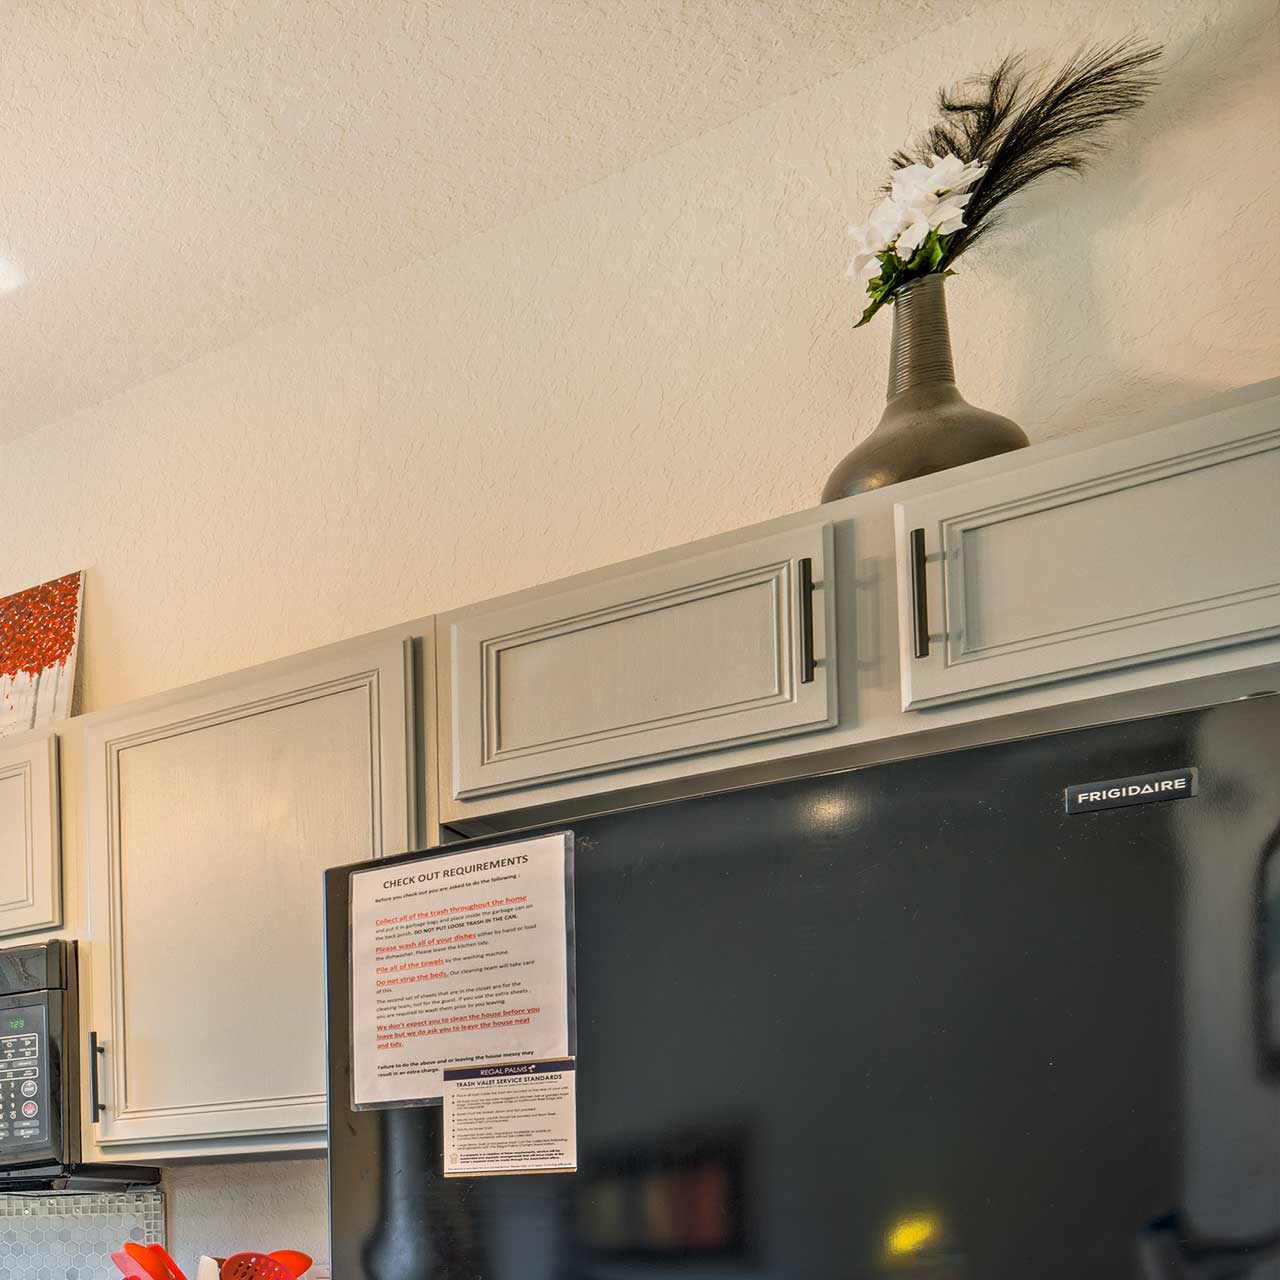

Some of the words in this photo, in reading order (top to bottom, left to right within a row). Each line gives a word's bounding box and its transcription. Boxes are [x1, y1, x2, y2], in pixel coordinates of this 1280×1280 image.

[1077, 778, 1187, 804] FRIGIDAIRE
[383, 875, 416, 889] CHECK
[418, 871, 440, 883] OUT
[443, 855, 529, 878] REQUIREMENTS
[491, 874, 517, 882] following
[376, 917, 398, 926] Collect
[450, 902, 491, 913] throughout
[399, 942, 417, 950] wash
[437, 937, 452, 945] your
[376, 966, 390, 974] Pile
[421, 959, 444, 967] towels
[461, 967, 483, 975] cleaning
[406, 1020, 428, 1028] expect
[505, 1066, 528, 1074] PALMS
